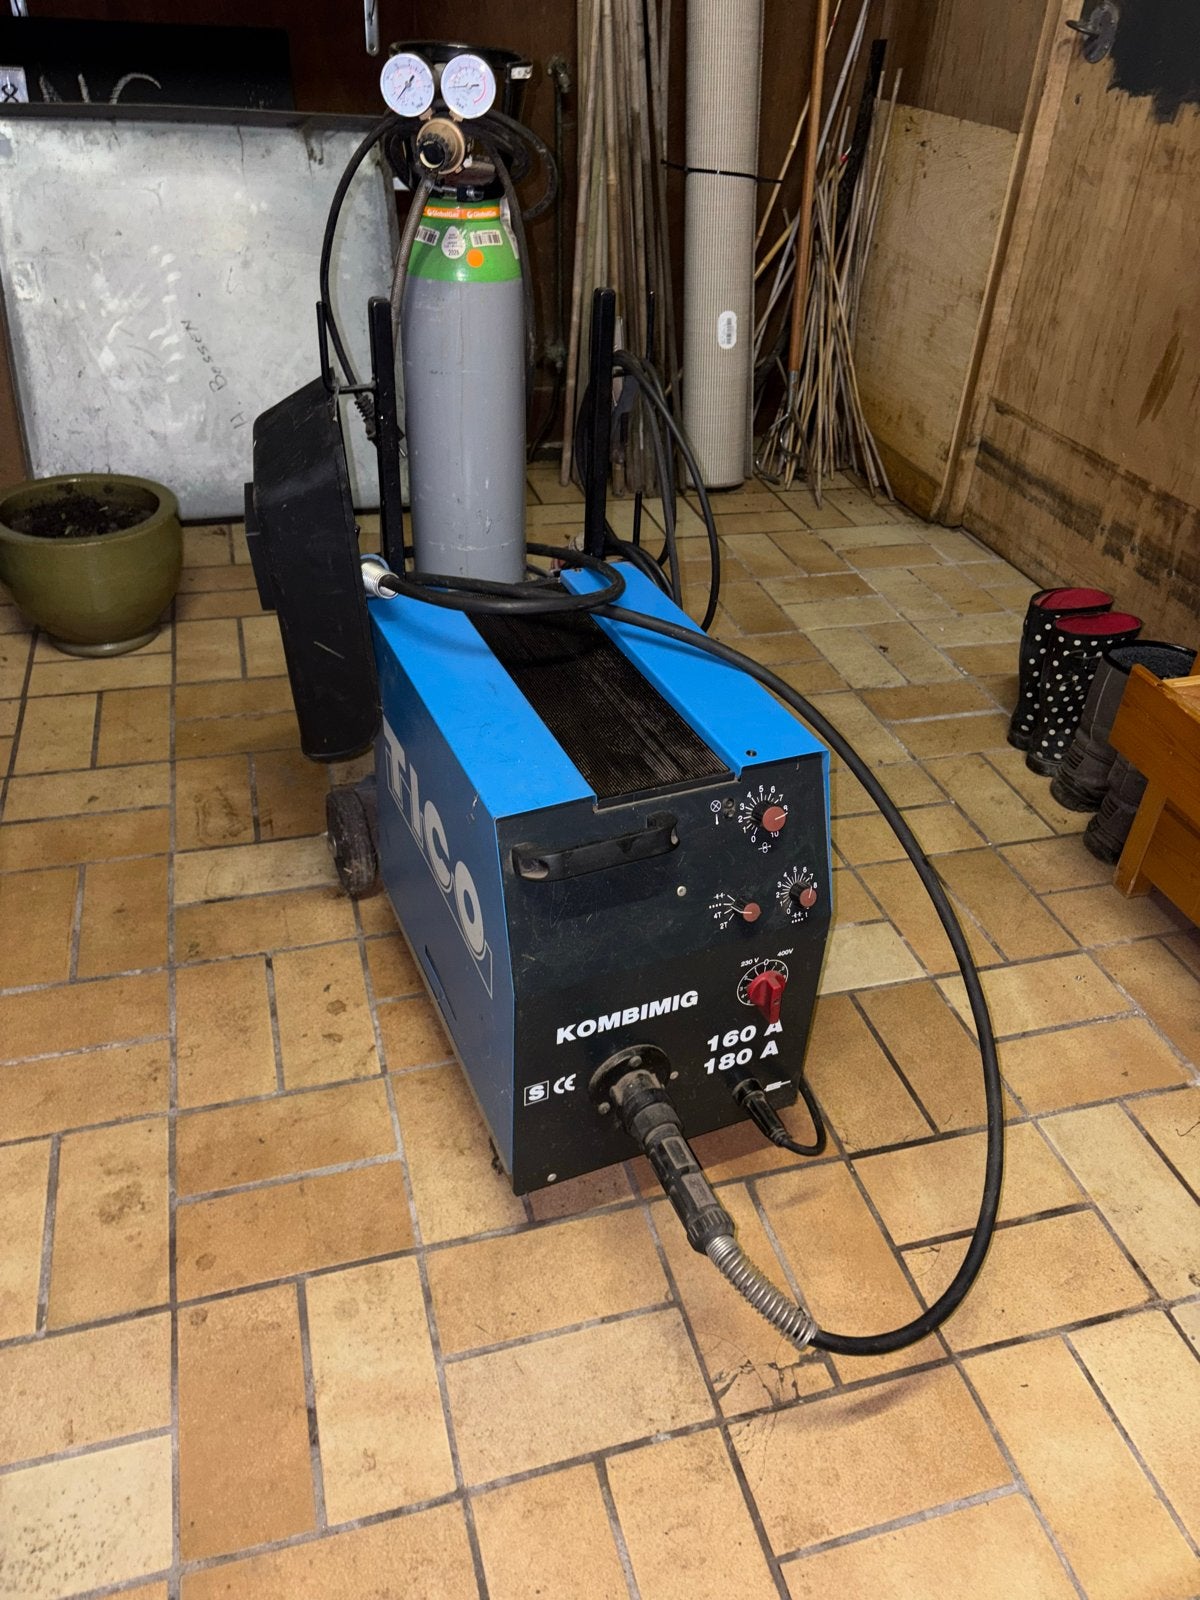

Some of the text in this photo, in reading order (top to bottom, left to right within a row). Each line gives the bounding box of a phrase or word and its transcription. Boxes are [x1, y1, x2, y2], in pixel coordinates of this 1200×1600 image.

[758, 784, 764, 793] 5
[770, 785, 776, 794] 6
[746, 791, 752, 799] 4
[778, 793, 784, 801] 7
[739, 802, 745, 811] 3
[737, 815, 744, 823] 2
[382, 714, 486, 961] TICO
[775, 891, 780, 899] 2
[792, 865, 798, 873] 5
[713, 911, 722, 919] 4T
[719, 921, 728, 930] 2T
[556, 990, 699, 1045] KOMBIMIG
[706, 1019, 783, 1052] 160 A
[703, 1040, 779, 1075] 180 A
[553, 1073, 577, 1095] CE
